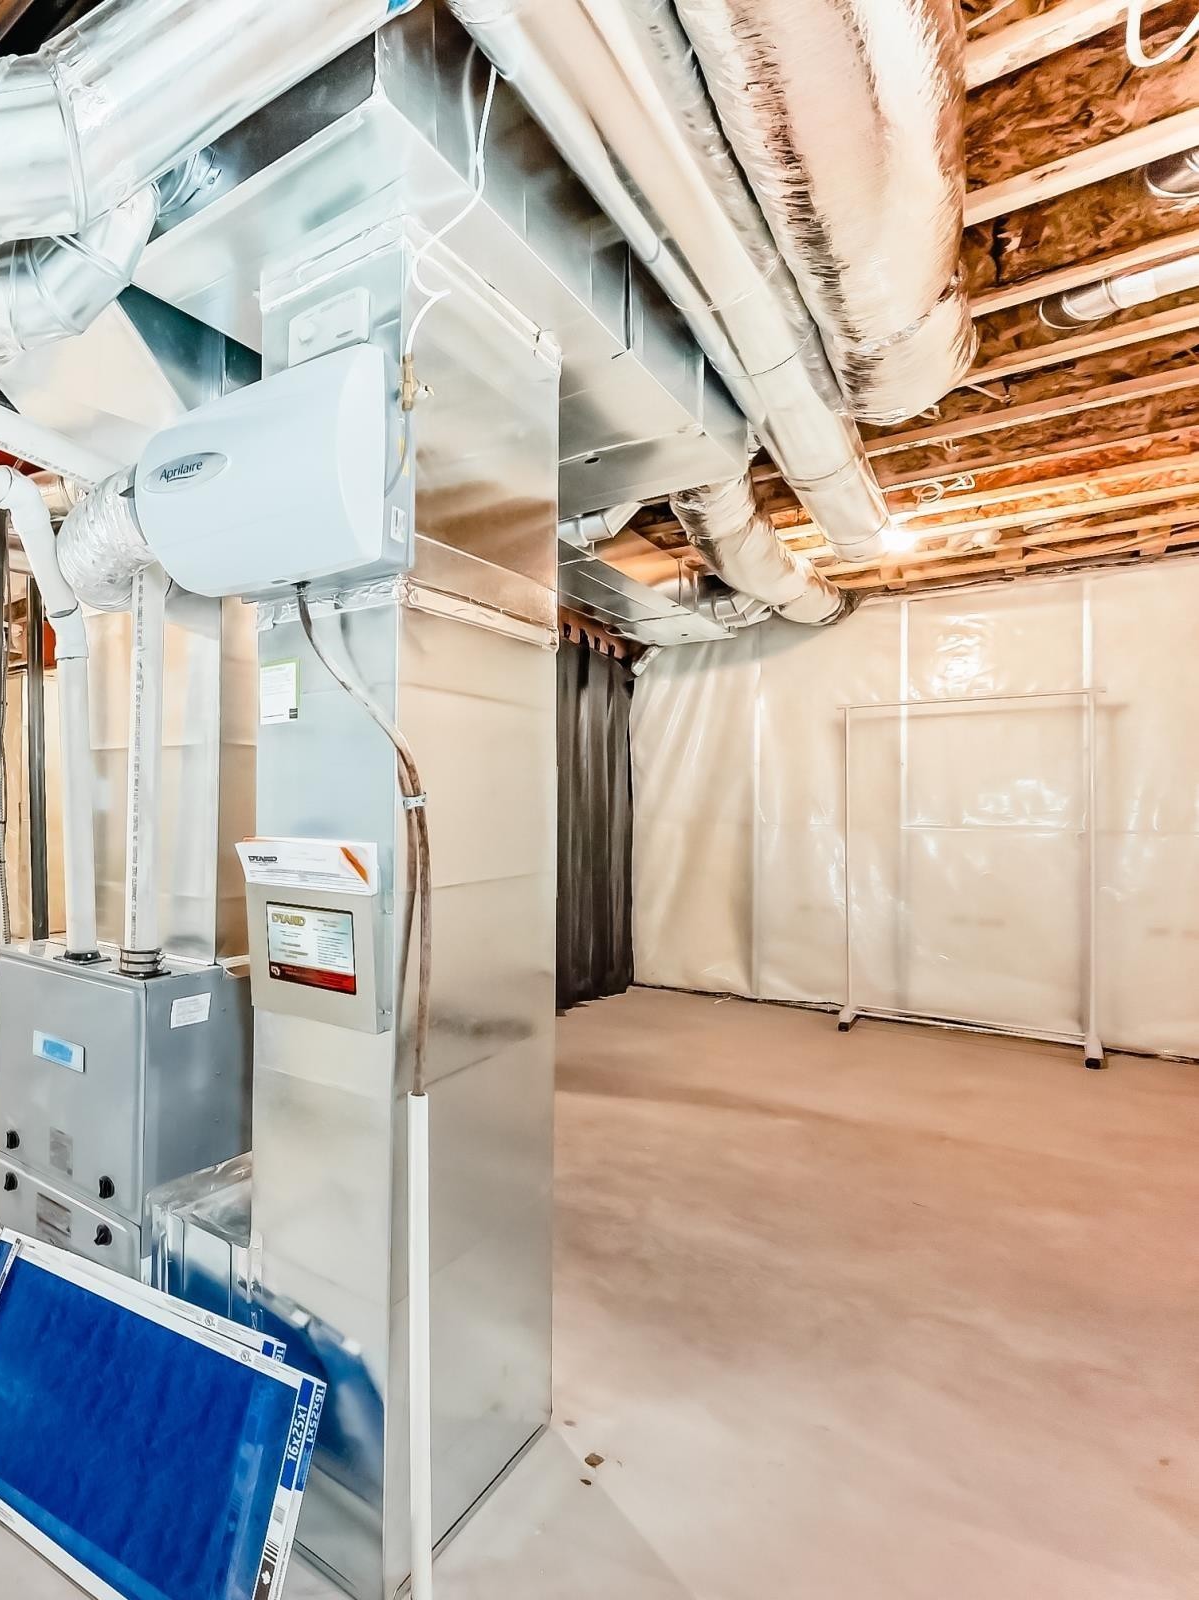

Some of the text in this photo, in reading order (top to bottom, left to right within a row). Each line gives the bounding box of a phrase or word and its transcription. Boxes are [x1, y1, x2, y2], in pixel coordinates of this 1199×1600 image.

[159, 461, 203, 483] Aprilaire
[286, 1404, 309, 1462] 16x25x1
[305, 1384, 327, 1444] 16x25x1
